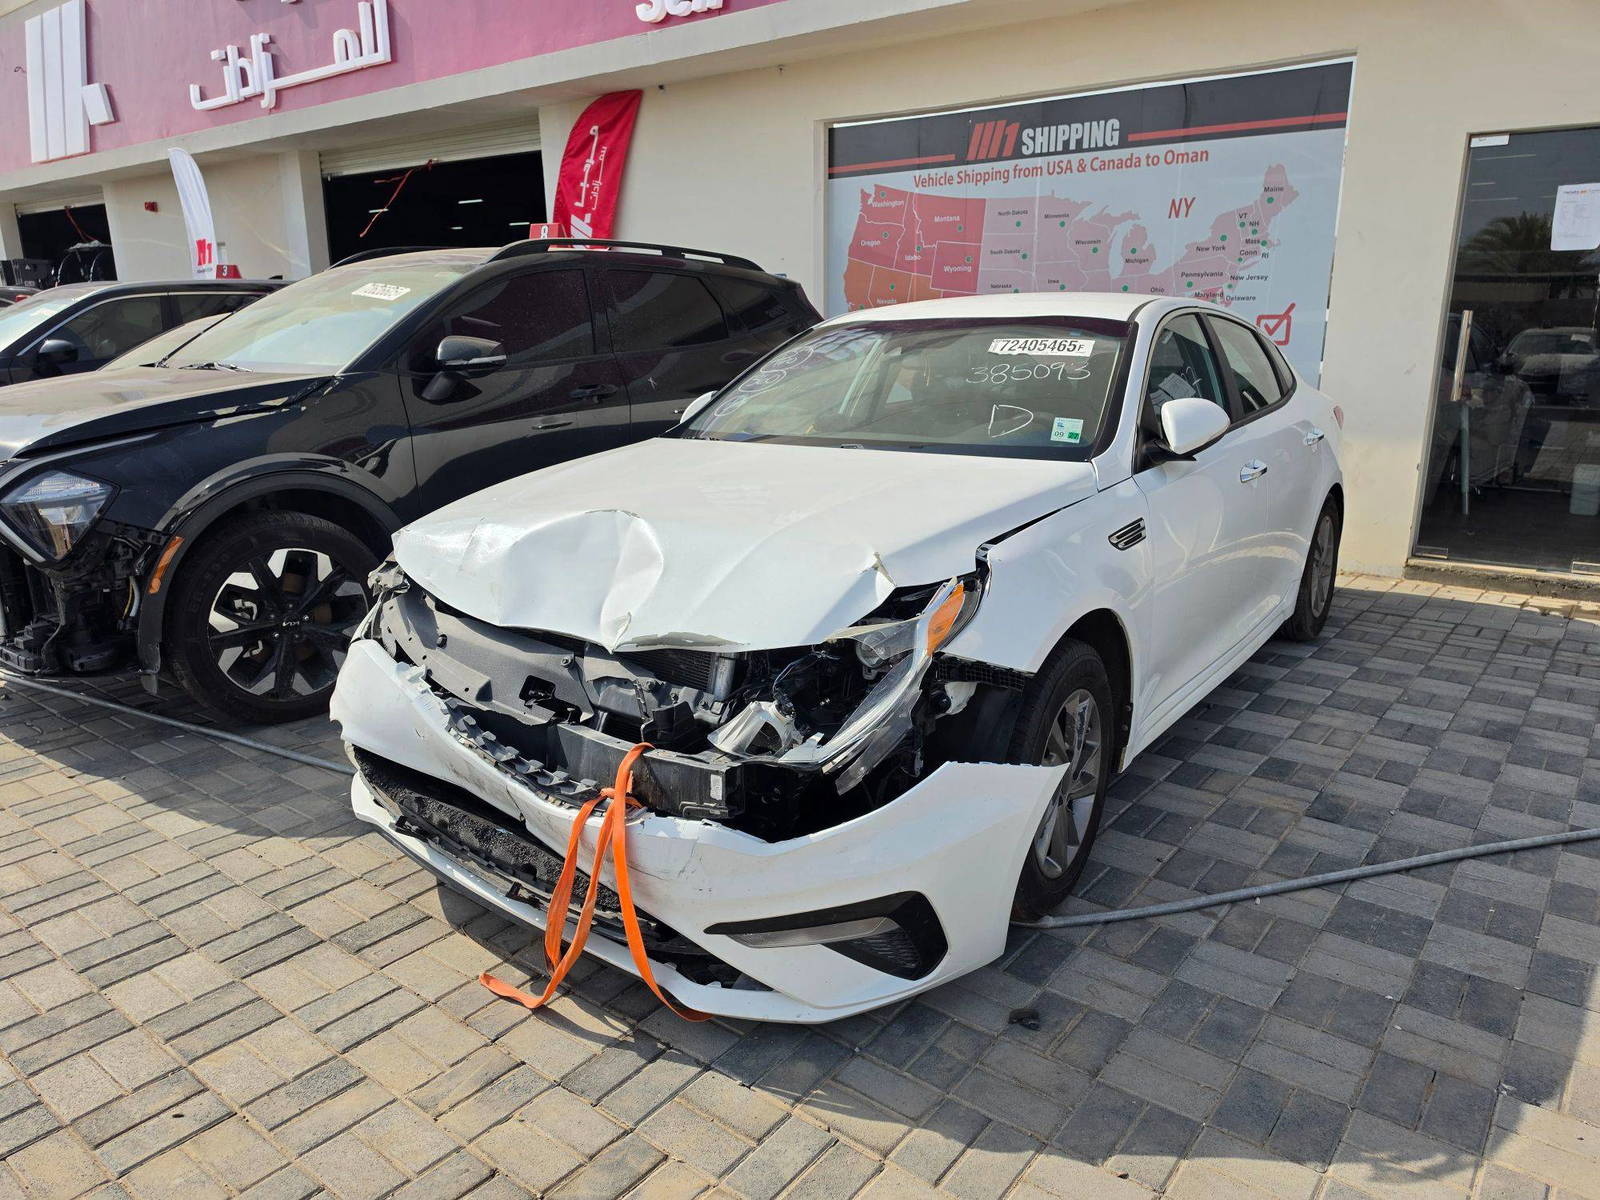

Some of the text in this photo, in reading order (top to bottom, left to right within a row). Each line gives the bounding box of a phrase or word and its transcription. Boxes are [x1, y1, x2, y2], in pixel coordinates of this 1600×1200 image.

[1021, 118, 1120, 155] SHIPPING
[914, 149, 1209, 188] Vehicle Shipping from USA & Canada to Oman
[1263, 185, 1284, 193] Maine
[872, 199, 905, 208] Washington
[1168, 196, 1197, 219] NY
[934, 214, 960, 223] Montana
[860, 239, 881, 248] Oregon
[1212, 244, 1226, 252] York
[1125, 257, 1149, 265] Michigan
[943, 265, 972, 273] Wyoming
[1181, 271, 1224, 279] Pennsylvania
[1246, 274, 1269, 282] Jersey
[1194, 291, 1224, 299] Maryland
[966, 360, 1091, 384] 385093
[987, 403, 1034, 438] D
